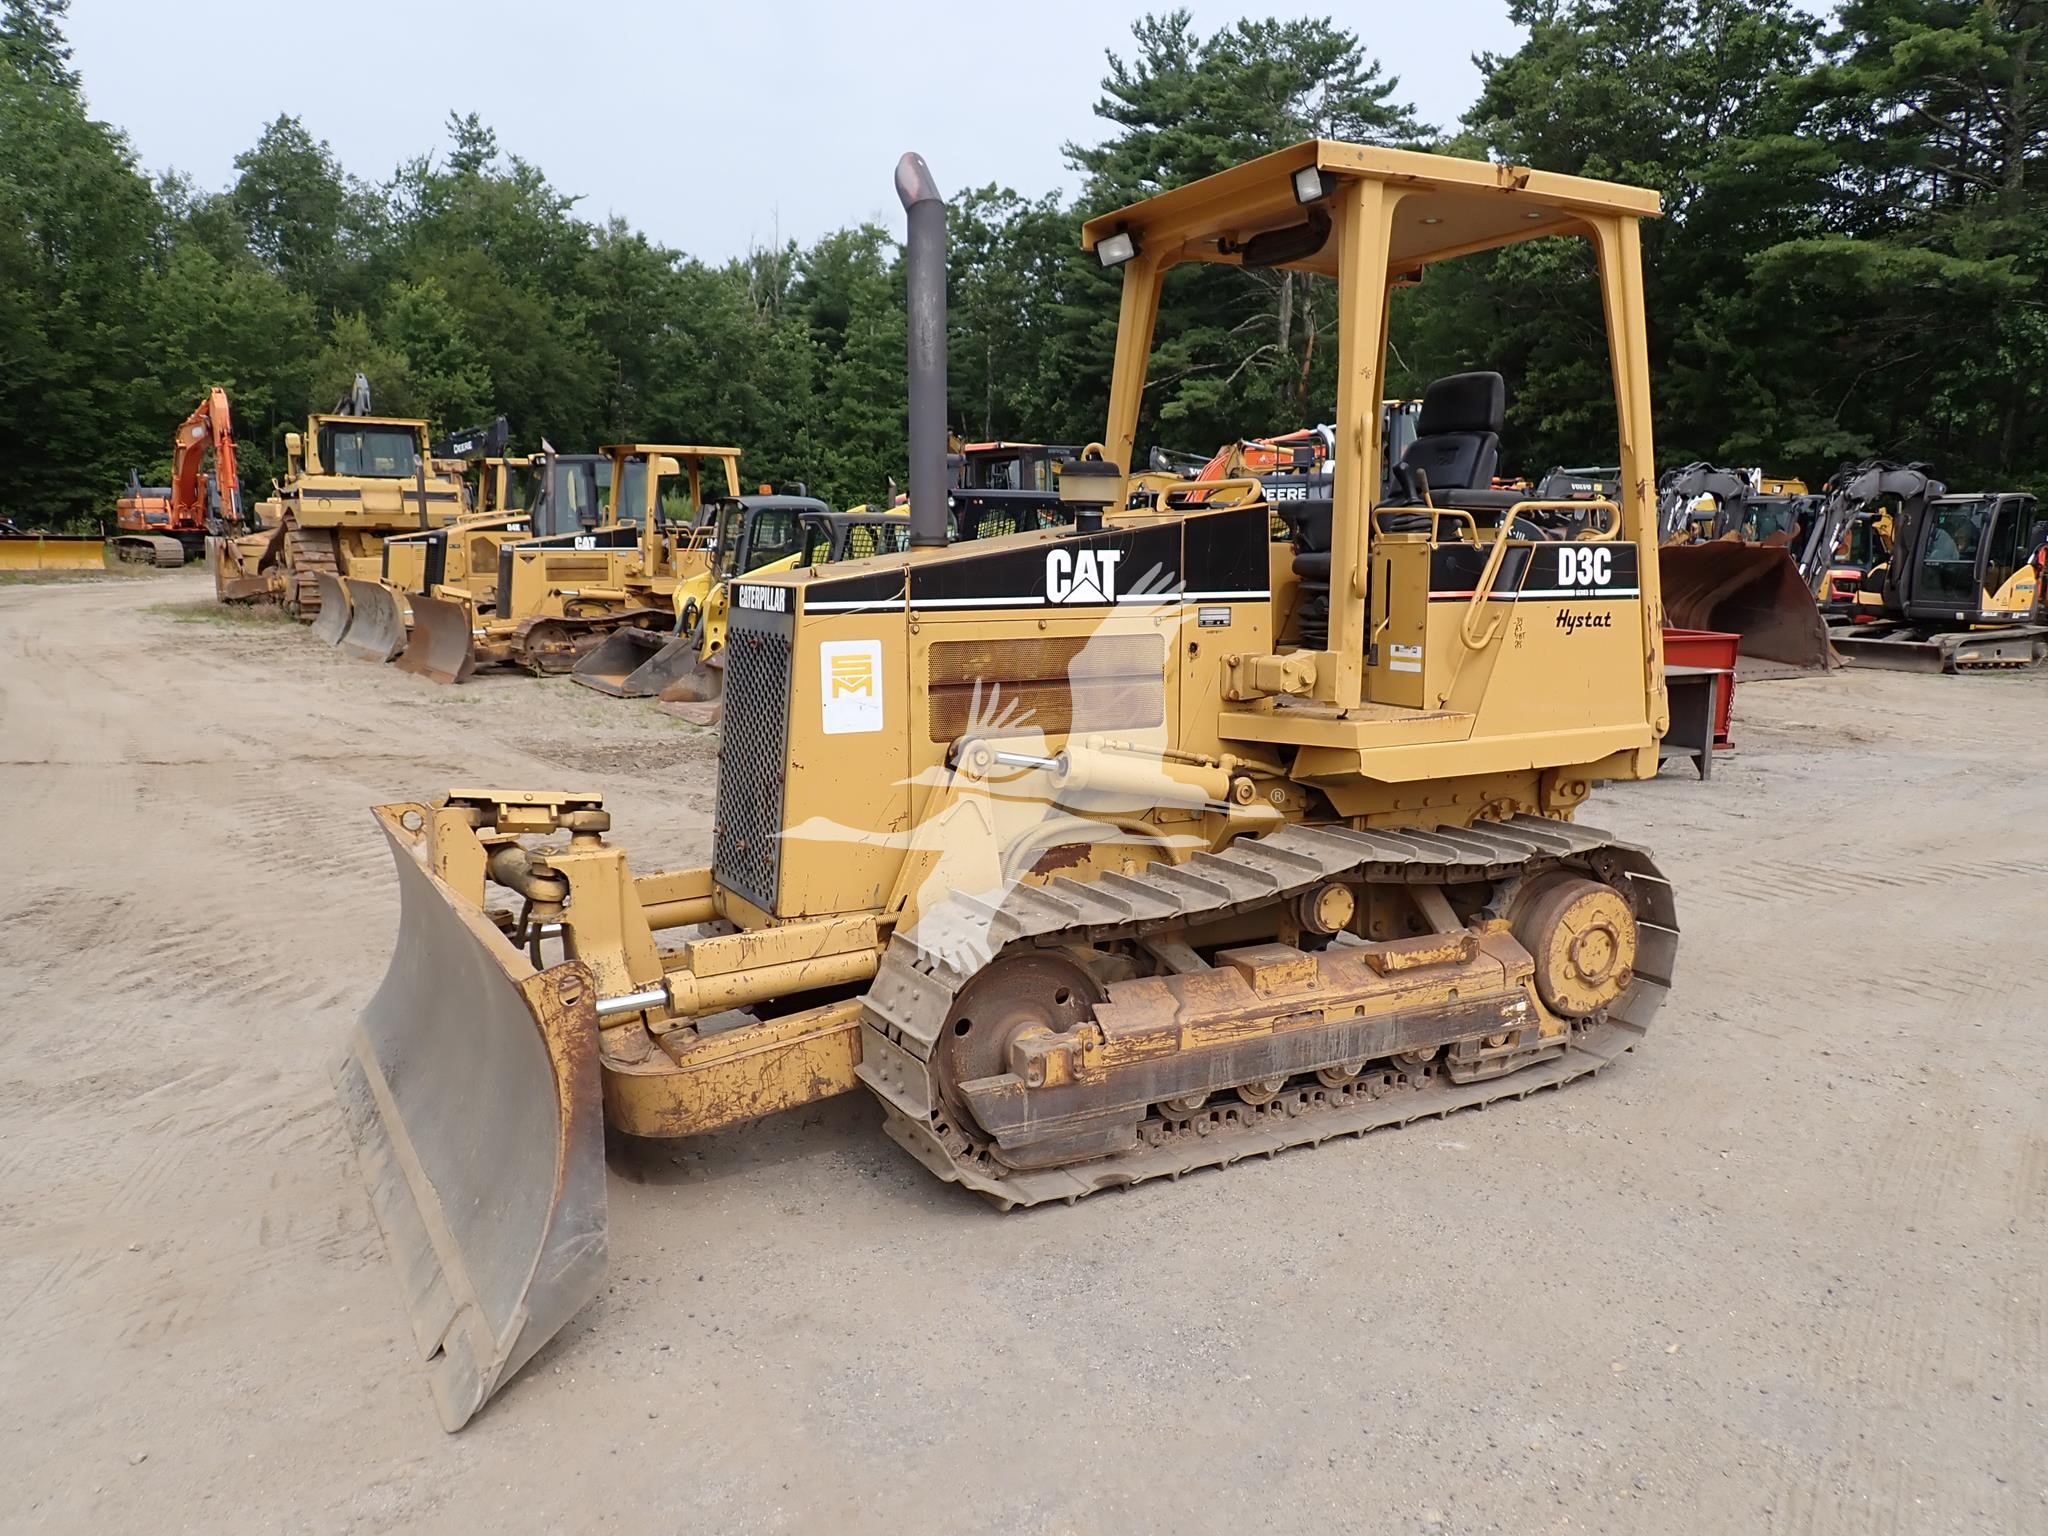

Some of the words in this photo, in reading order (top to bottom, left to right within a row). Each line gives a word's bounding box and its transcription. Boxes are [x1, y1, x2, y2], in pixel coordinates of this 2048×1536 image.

[453, 441, 473, 454] DEERE
[574, 537, 597, 550] CAT
[1046, 549, 1121, 604] CAT
[1558, 547, 1612, 586] D3C
[739, 585, 786, 613] CATERPILLAR
[1556, 609, 1612, 636] Hystat
